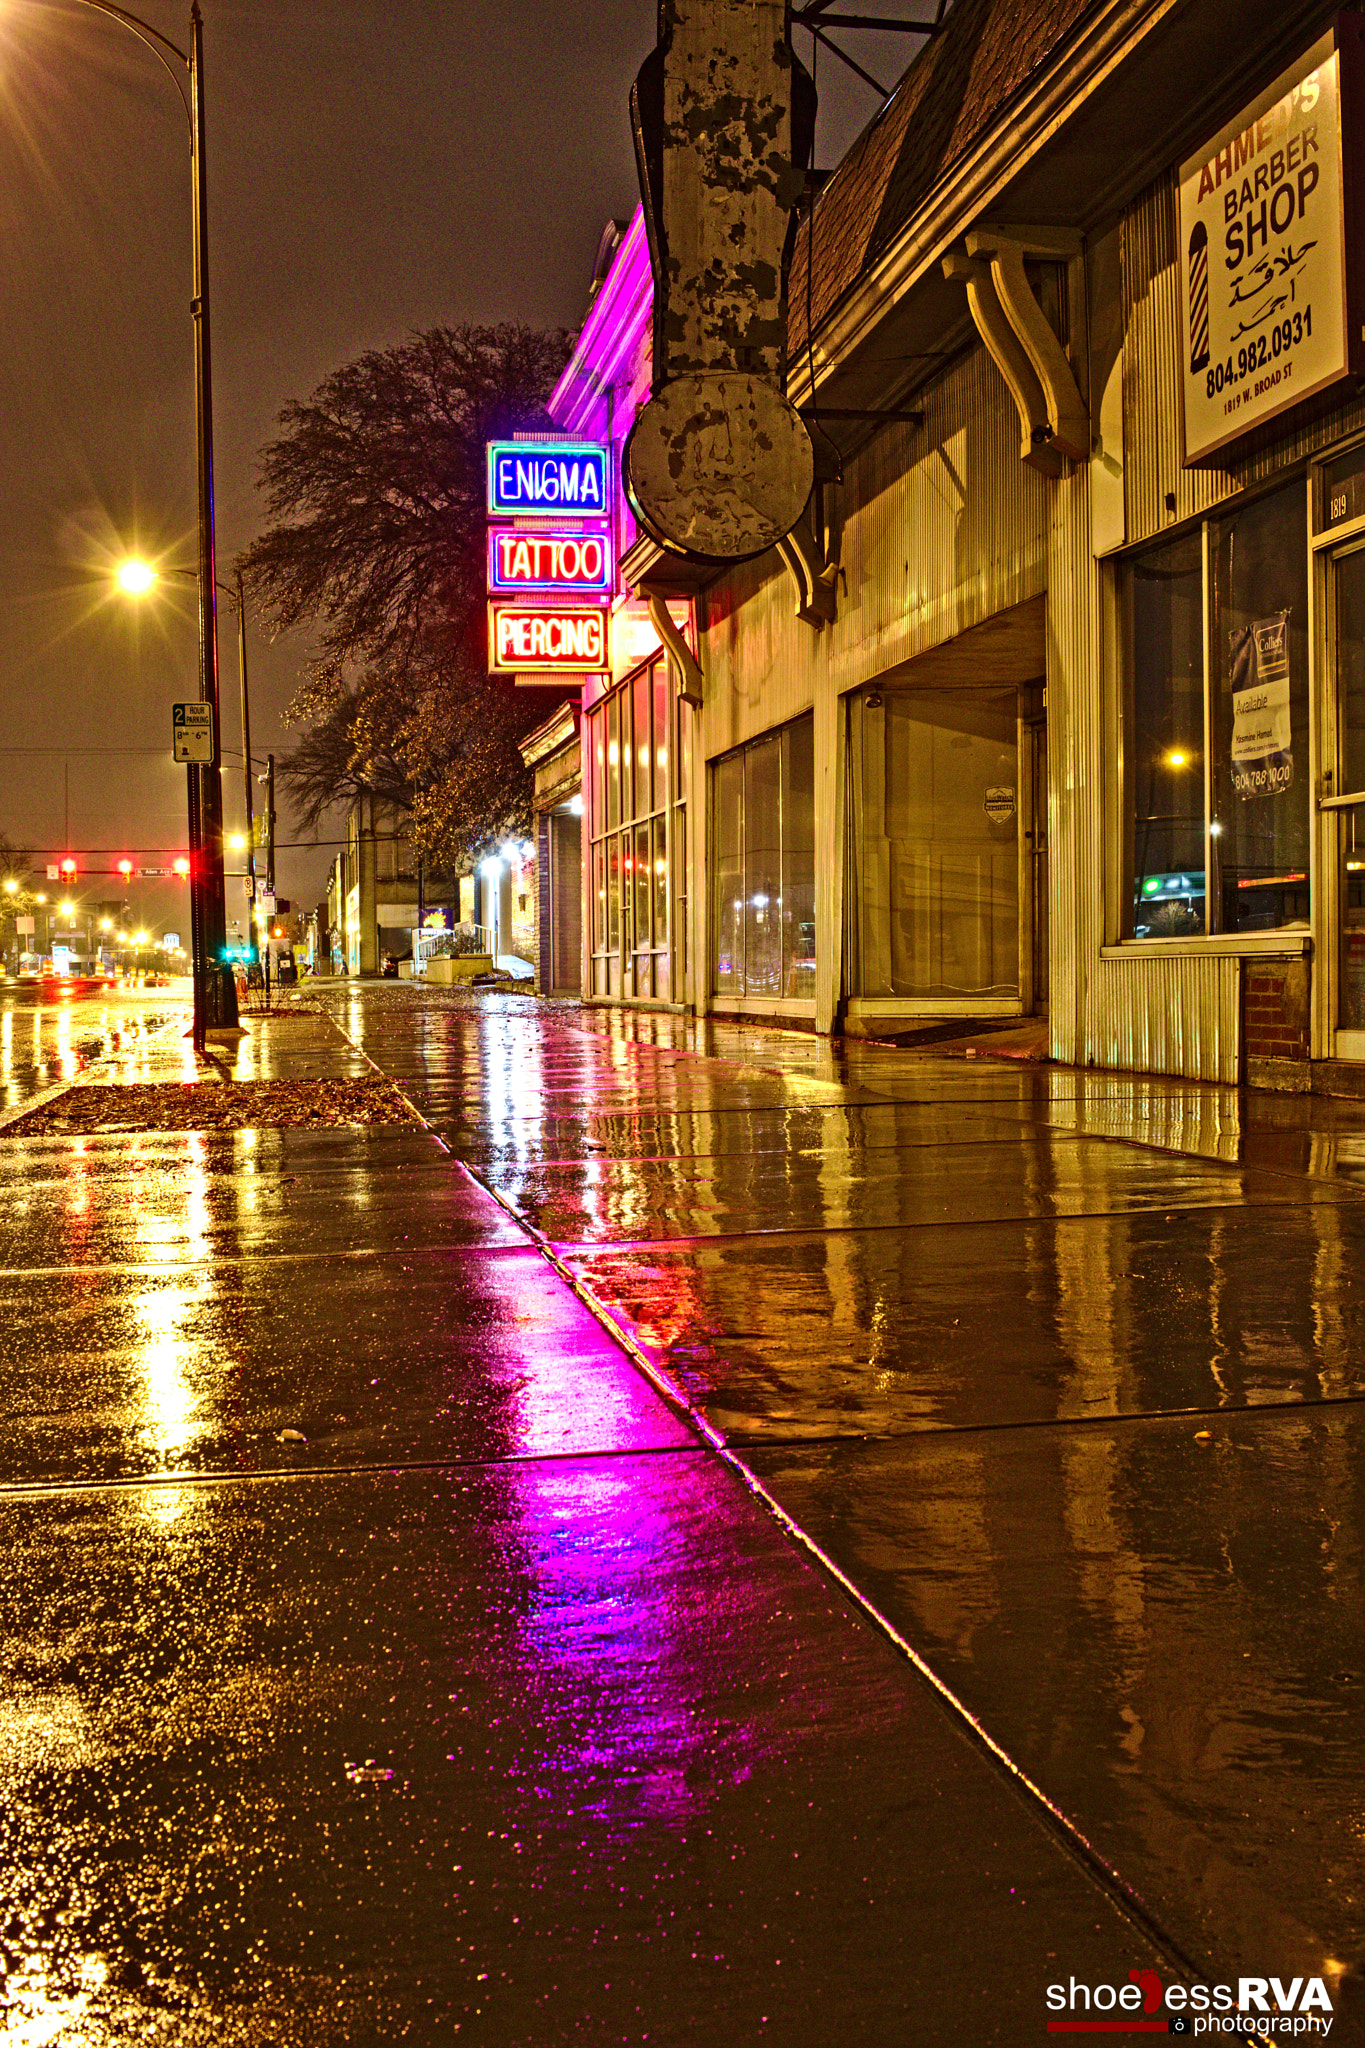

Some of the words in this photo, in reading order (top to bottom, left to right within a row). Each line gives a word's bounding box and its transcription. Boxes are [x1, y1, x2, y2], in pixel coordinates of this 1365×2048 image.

[1198, 71, 1320, 204] AHMED'S
[1224, 123, 1319, 224] BARBER
[1225, 161, 1320, 270] SHOP
[1206, 304, 1312, 399] 804.982.0931
[1223, 394, 1241, 416] 1819
[1243, 388, 1253, 404] W.
[1254, 370, 1281, 397] BROAD
[1283, 361, 1293, 380] ST
[499, 459, 600, 503] ENIGMA
[1330, 494, 1347, 520] 1819
[499, 539, 603, 580] TATTOO
[500, 617, 600, 657] PIERCING
[174, 708, 184, 723] 2
[189, 706, 205, 715] HOUR
[186, 715, 209, 724] PARKING
[1236, 693, 1268, 715] Available
[1250, 770, 1267, 786] 788
[1269, 765, 1290, 783] 1000
